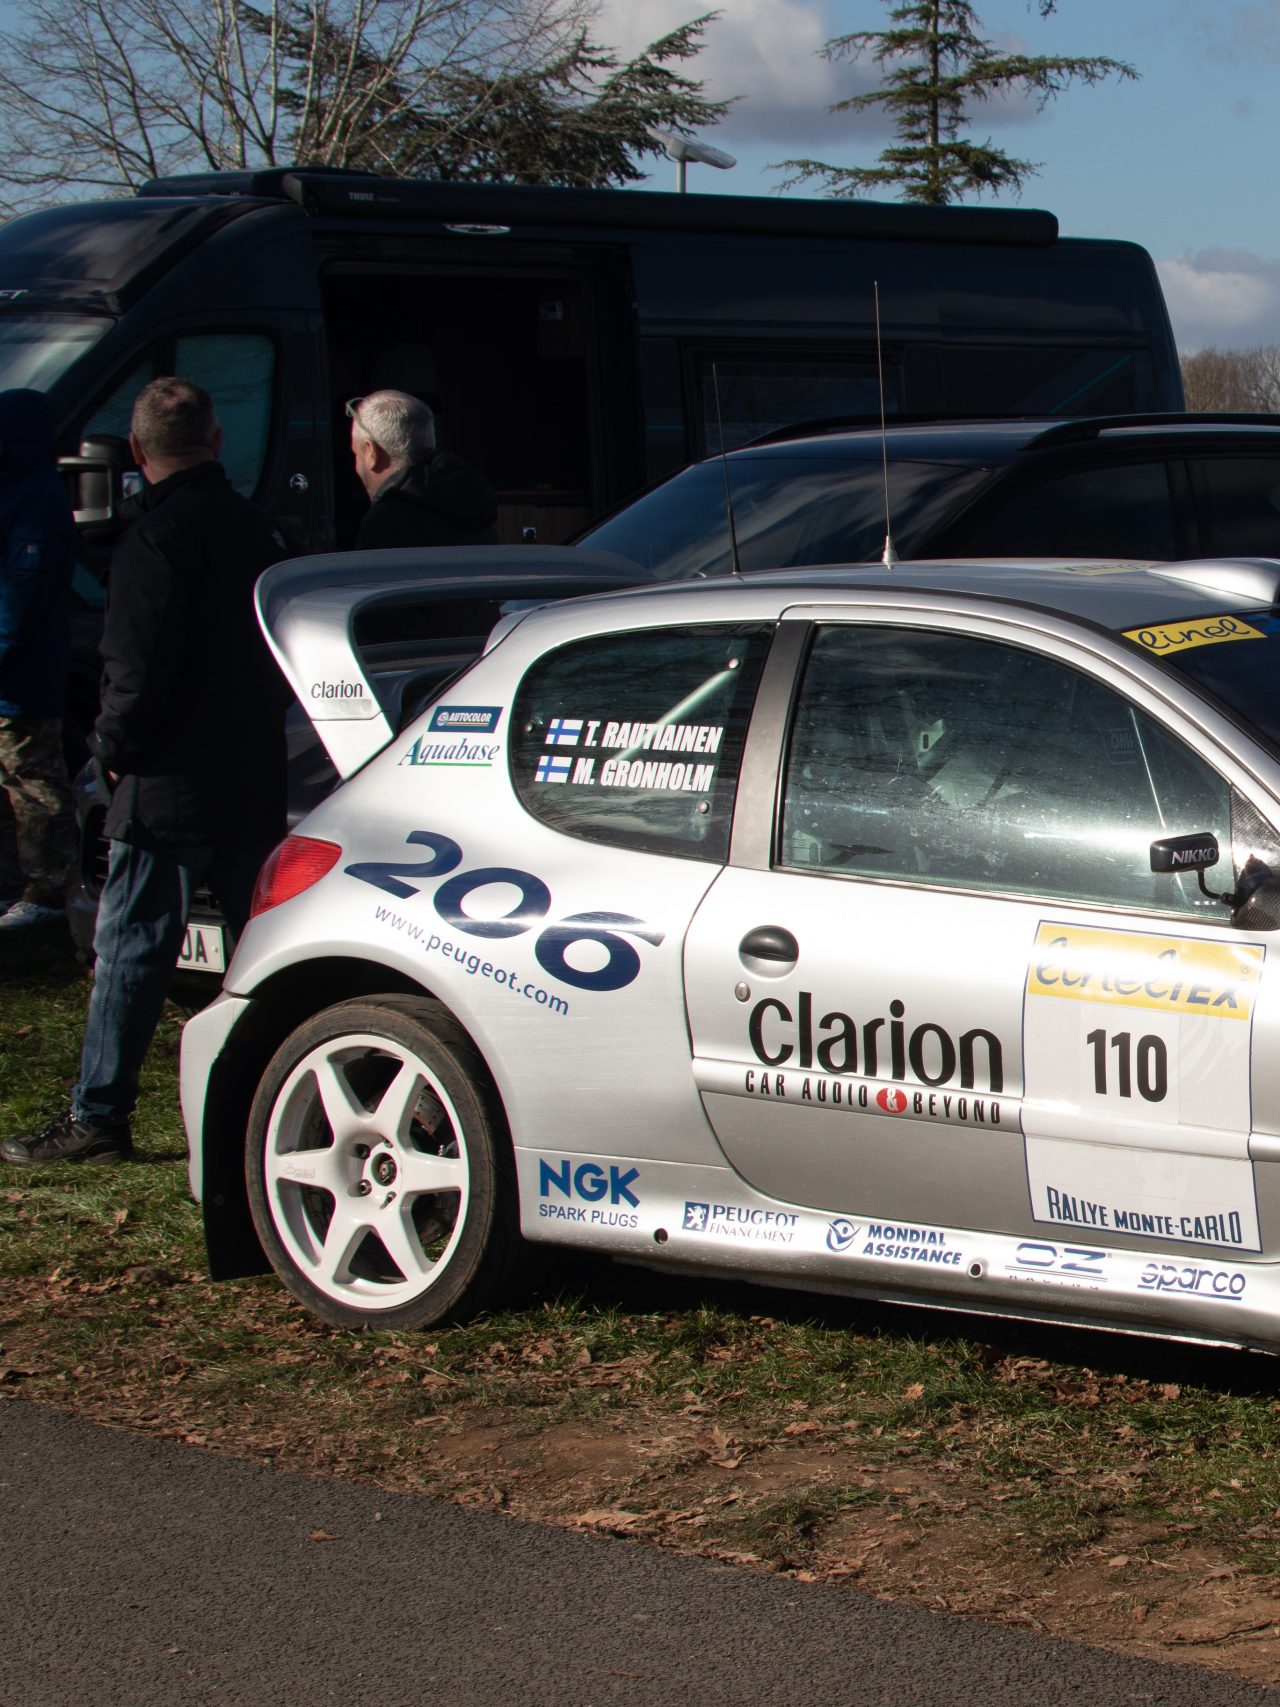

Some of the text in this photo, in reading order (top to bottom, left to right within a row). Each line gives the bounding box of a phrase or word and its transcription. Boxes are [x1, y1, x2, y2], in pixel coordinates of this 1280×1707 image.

[1137, 618, 1250, 650] linel
[448, 712, 493, 723] AUTOCOLOR
[398, 733, 501, 766] Aquabase
[584, 720, 723, 753] T. RAUTIAINEN
[572, 757, 714, 792] M. GRONHOLM
[1171, 847, 1217, 865] NIKKO
[343, 830, 666, 991] 206
[374, 905, 570, 1016] www.peugeot.com
[749, 990, 1004, 1093] Clarion
[1086, 1028, 1168, 1103] 110
[745, 1069, 786, 1097] CAR
[801, 1077, 868, 1108] AUDIO
[913, 1091, 1001, 1125] BEYOND
[539, 1157, 641, 1209] NGK
[538, 1203, 639, 1229] SPARK PLUGS
[711, 1204, 800, 1228] PEUGEOT
[1046, 1185, 1243, 1245] RALLYE MONTE-CARLO
[867, 1224, 947, 1247] MONDIAL
[861, 1242, 963, 1265] ASSISTANCE
